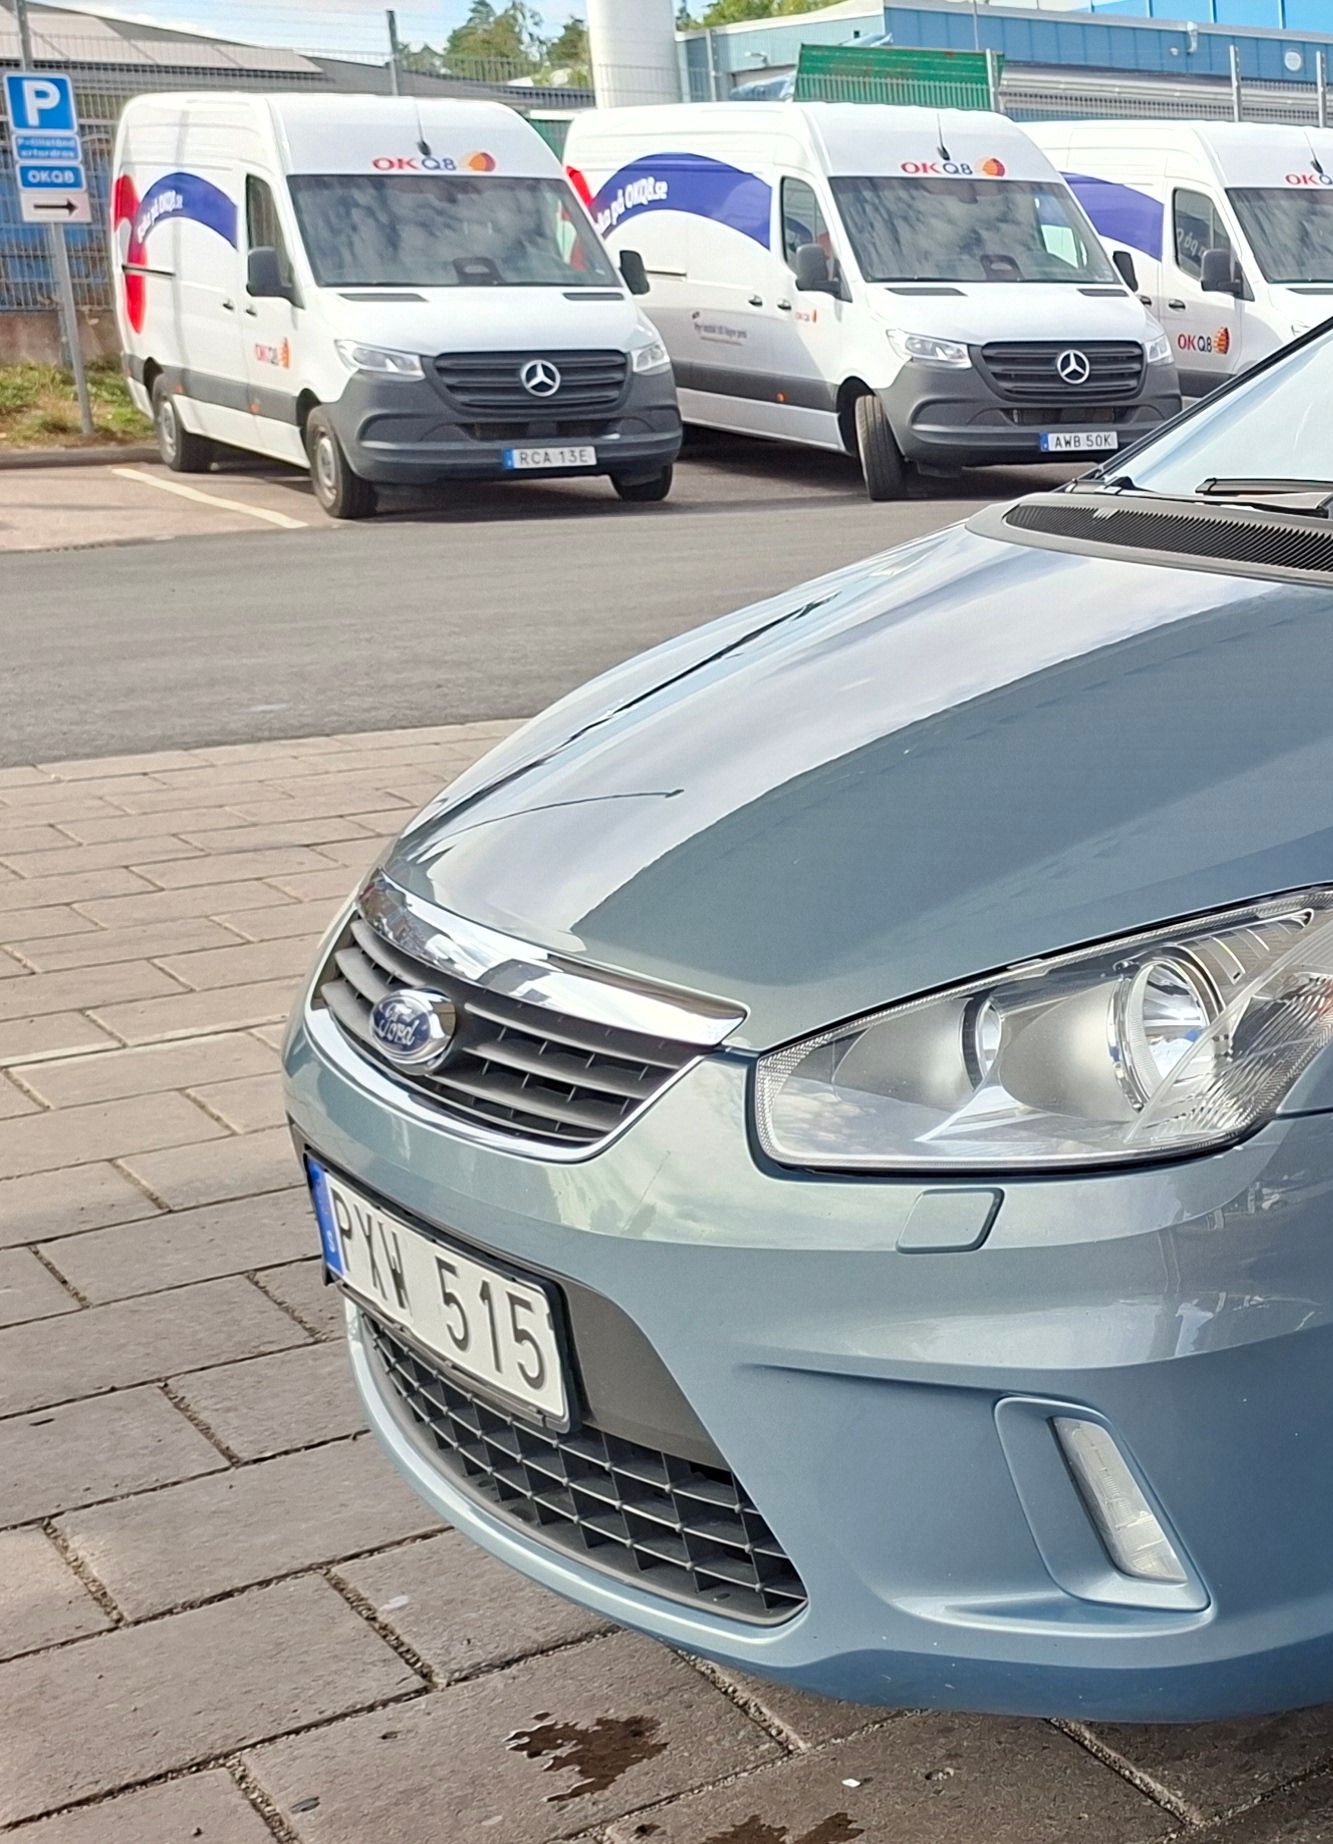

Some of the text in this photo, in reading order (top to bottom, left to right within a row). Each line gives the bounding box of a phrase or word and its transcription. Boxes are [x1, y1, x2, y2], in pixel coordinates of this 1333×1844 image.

[22, 80, 61, 127] P
[372, 157, 456, 171] OKQ8
[901, 162, 973, 175] OKQ8
[27, 169, 75, 184] OKQ8
[624, 176, 668, 209] OKQ8.se
[1178, 334, 1213, 353] OKQ8
[1054, 434, 1112, 449] AWB 50K
[520, 448, 589, 466] RCA 13E
[376, 1002, 420, 1047] Ford
[435, 1253, 546, 1391] 515
